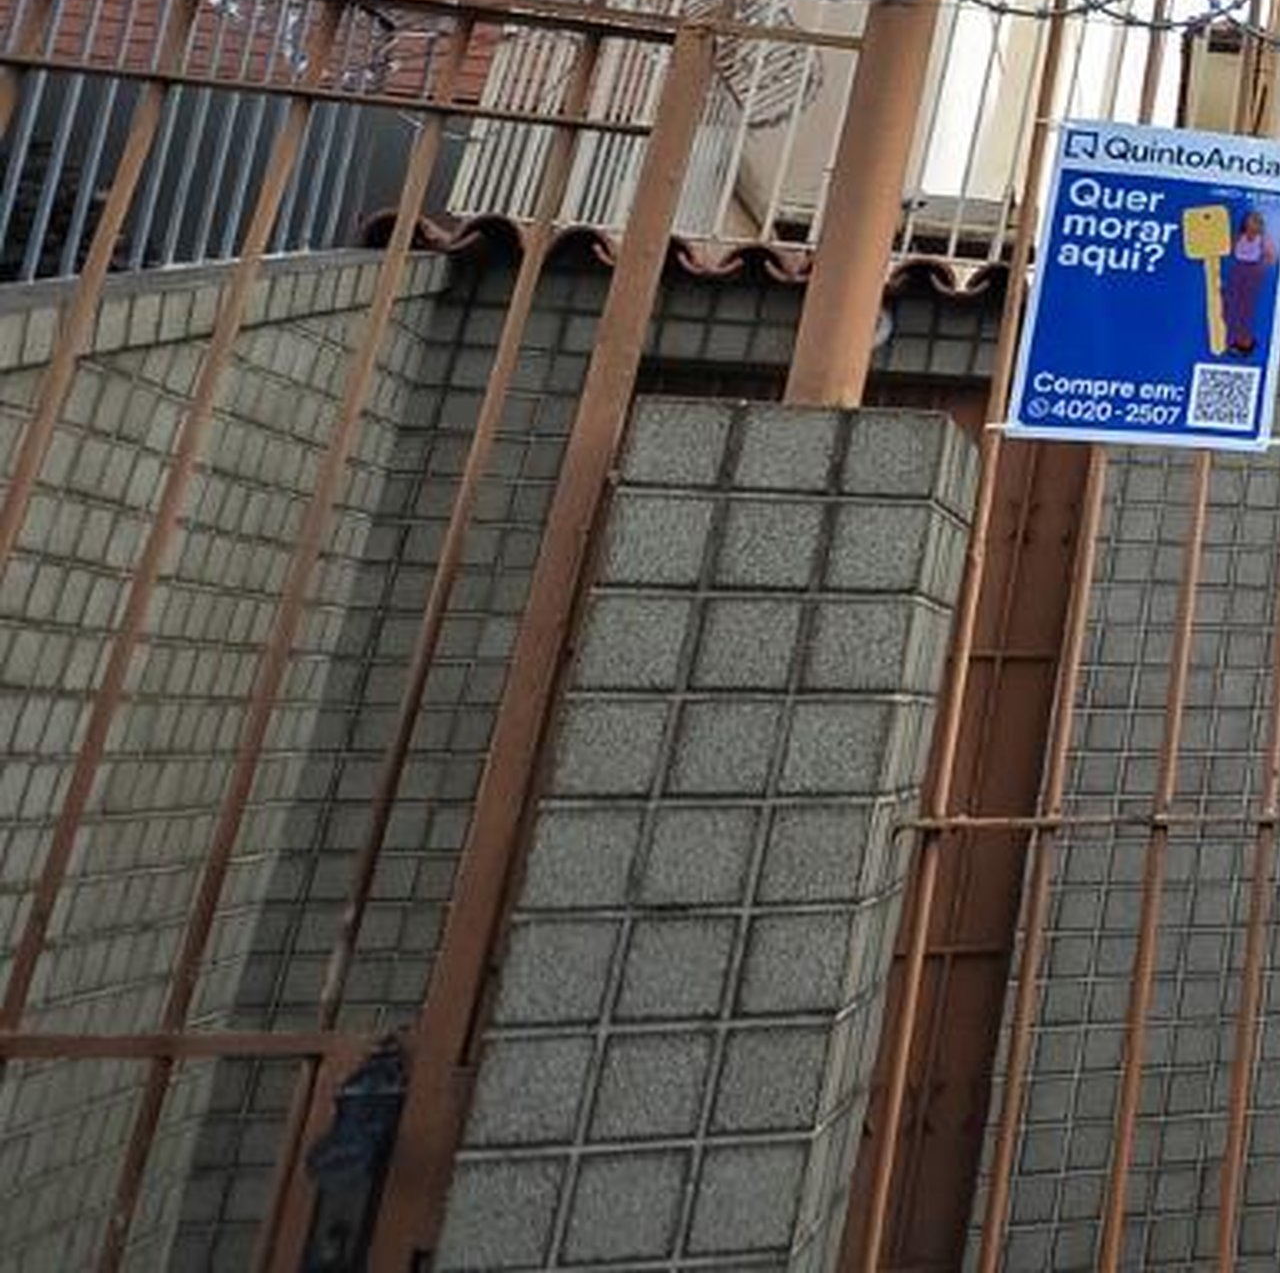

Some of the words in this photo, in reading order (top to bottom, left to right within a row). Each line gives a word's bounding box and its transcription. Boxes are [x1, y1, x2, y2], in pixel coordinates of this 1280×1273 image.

[1070, 178, 1165, 212] Quer
[1063, 213, 1179, 243] morar
[1057, 243, 1165, 276] aqui?
[1033, 371, 1135, 399] Compre
[1139, 382, 1185, 402] em:
